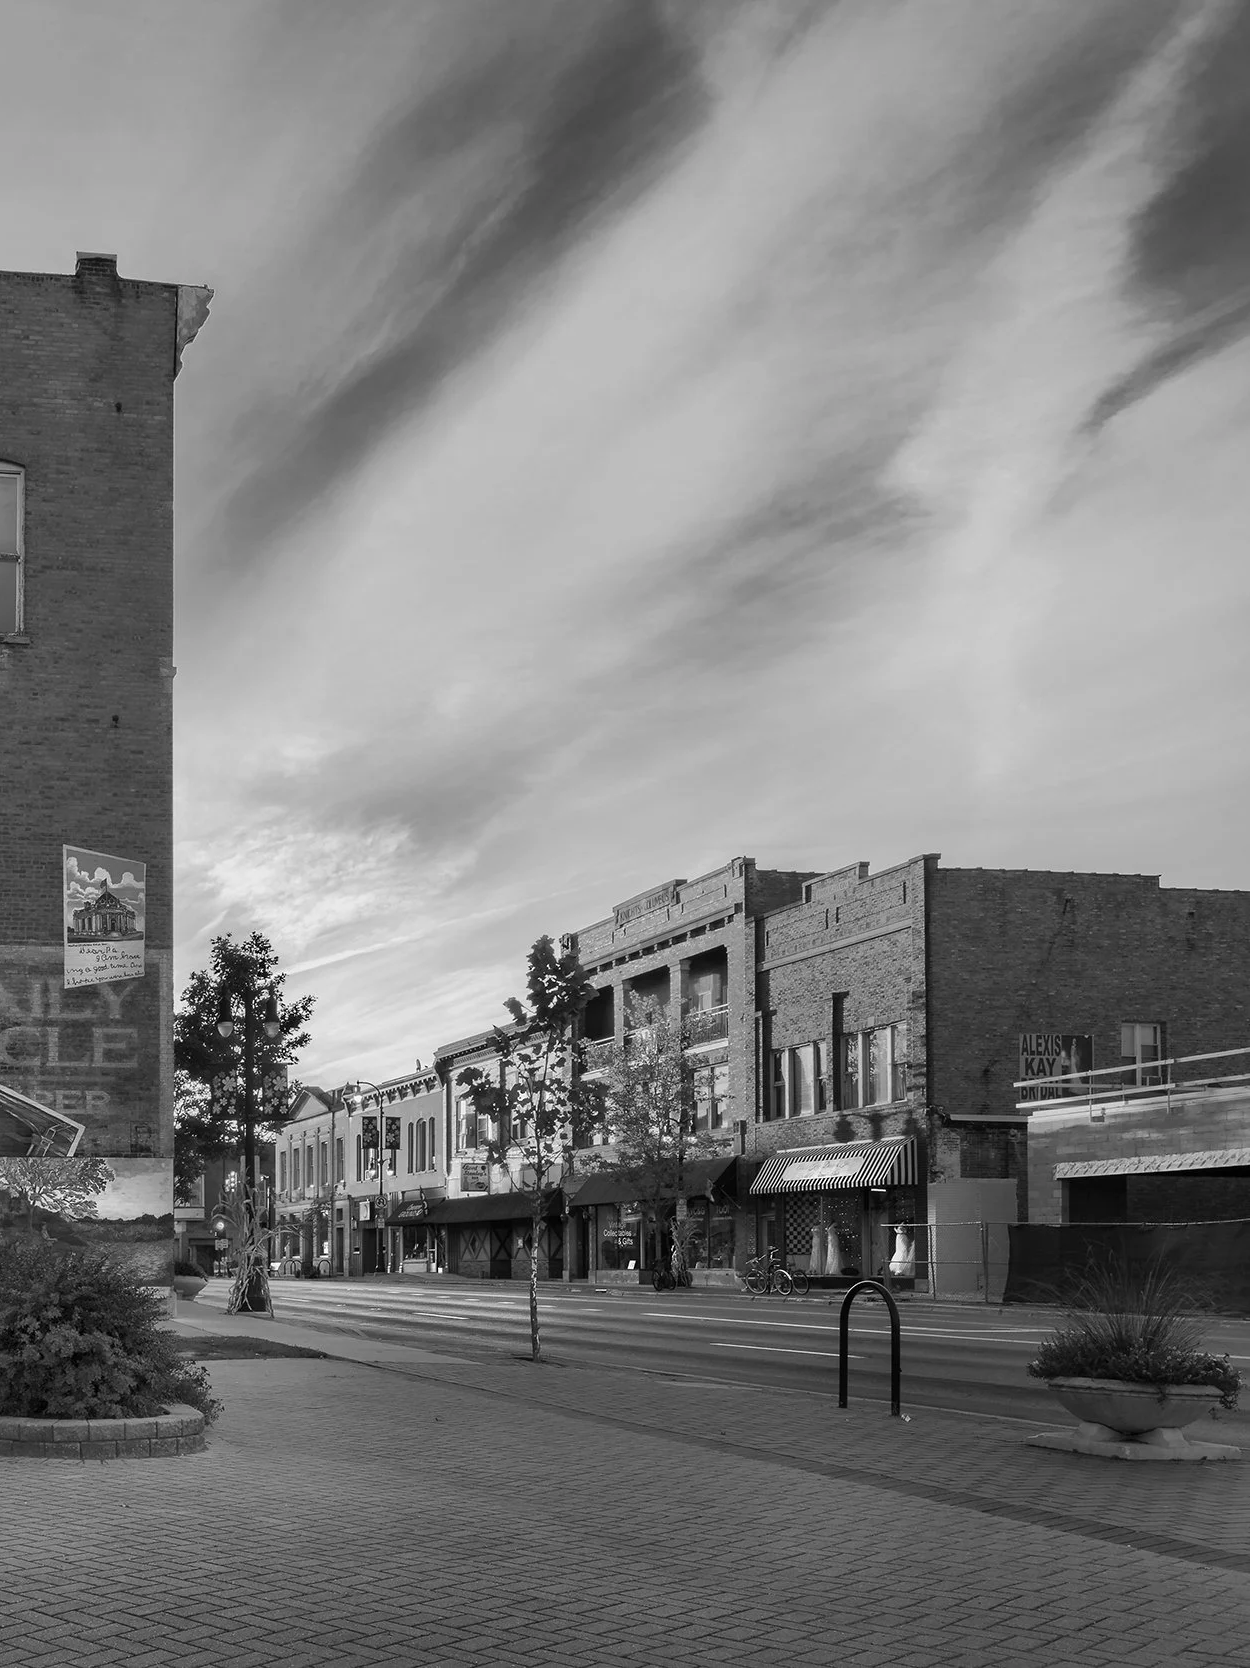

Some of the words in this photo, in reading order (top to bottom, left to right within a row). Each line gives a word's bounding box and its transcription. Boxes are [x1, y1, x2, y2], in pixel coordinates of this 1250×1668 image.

[1021, 1034, 1061, 1056] ALEXIS
[1024, 1057, 1056, 1076] KAY
[1021, 1077, 1062, 1100] BRIDAL
